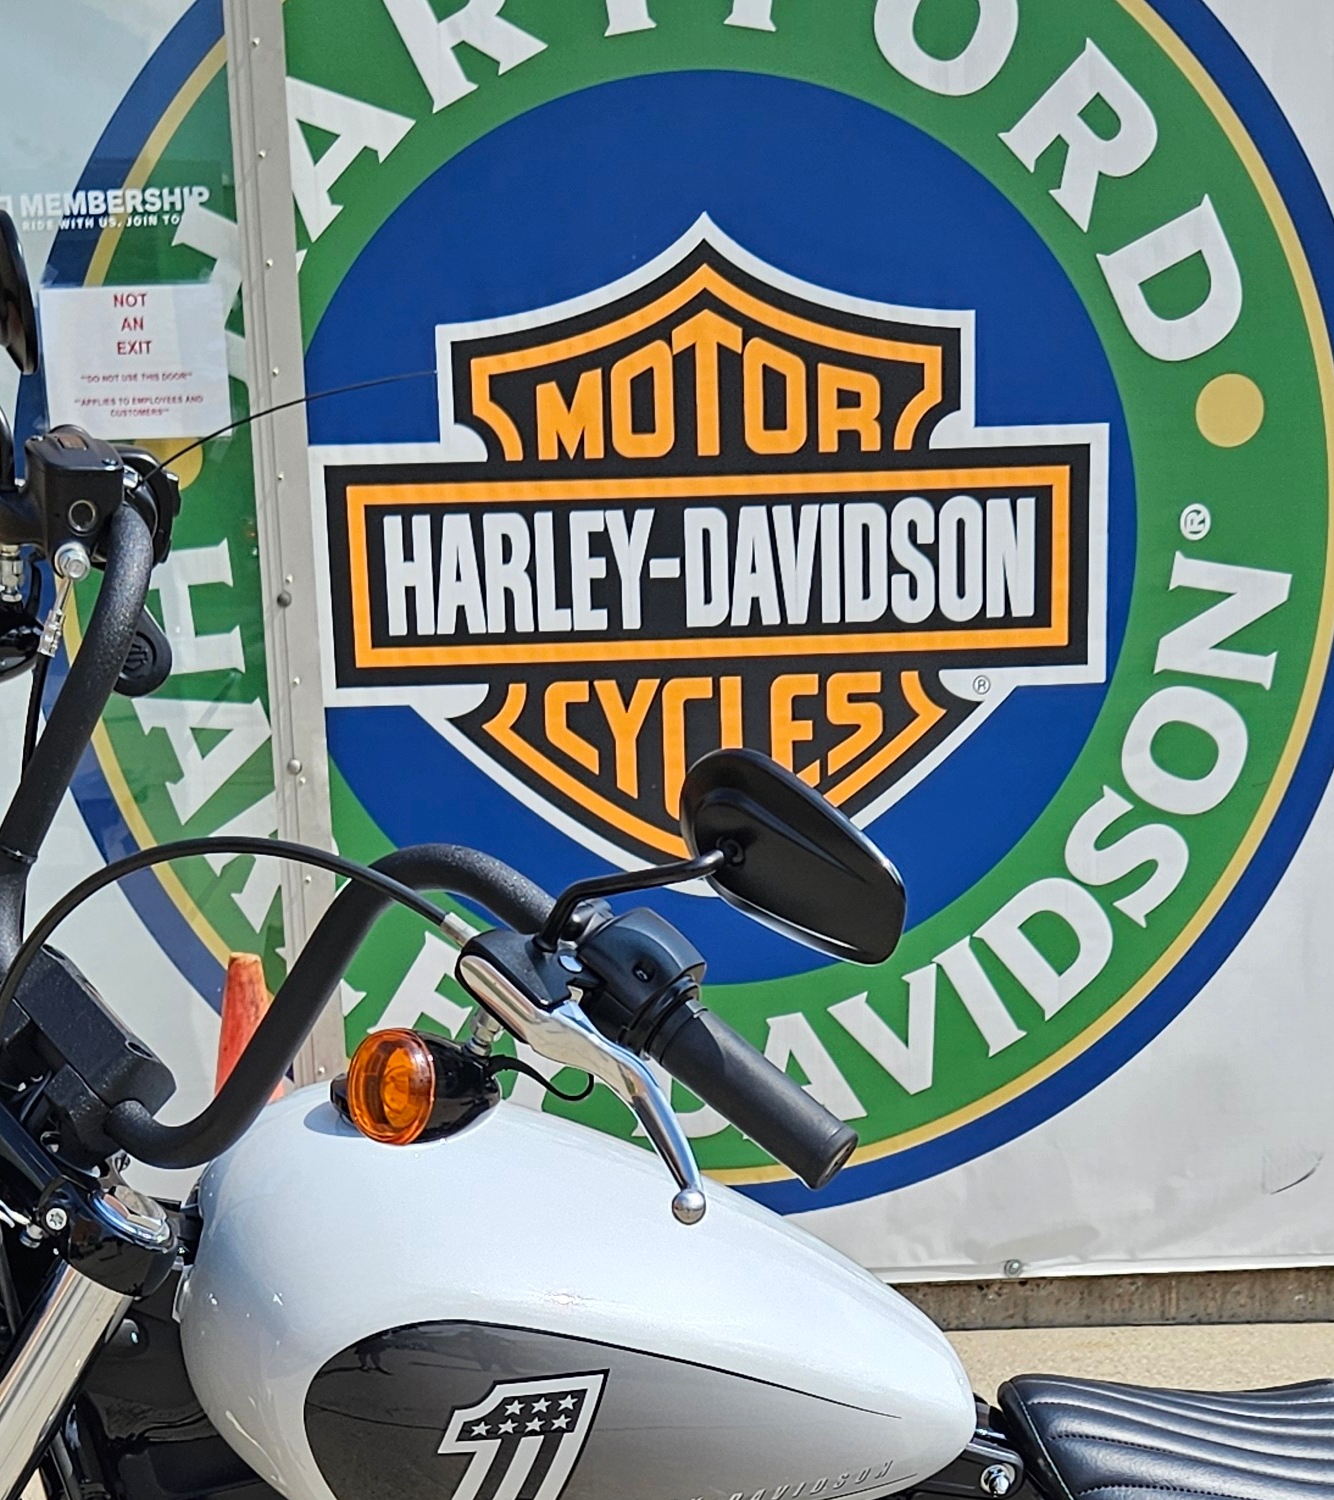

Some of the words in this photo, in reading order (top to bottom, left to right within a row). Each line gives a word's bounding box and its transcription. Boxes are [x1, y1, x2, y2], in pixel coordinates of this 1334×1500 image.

[20, 186, 209, 218] MEMBERSHIP
[23, 217, 54, 231] RIDE
[59, 216, 94, 229] WITH
[126, 214, 158, 227] JOIN
[113, 293, 147, 308] NOT
[121, 316, 144, 331] AN
[116, 340, 152, 355] EXIT
[102, 374, 120, 383] NOT
[121, 373, 138, 382] USE
[141, 372, 160, 382] THIS
[535, 308, 882, 461] MOTOR
[118, 396, 130, 406] TO
[131, 395, 183, 405] EMPLOYEES
[185, 394, 204, 404] AND
[383, 495, 1037, 637] HARLEY-DAVIDSON
